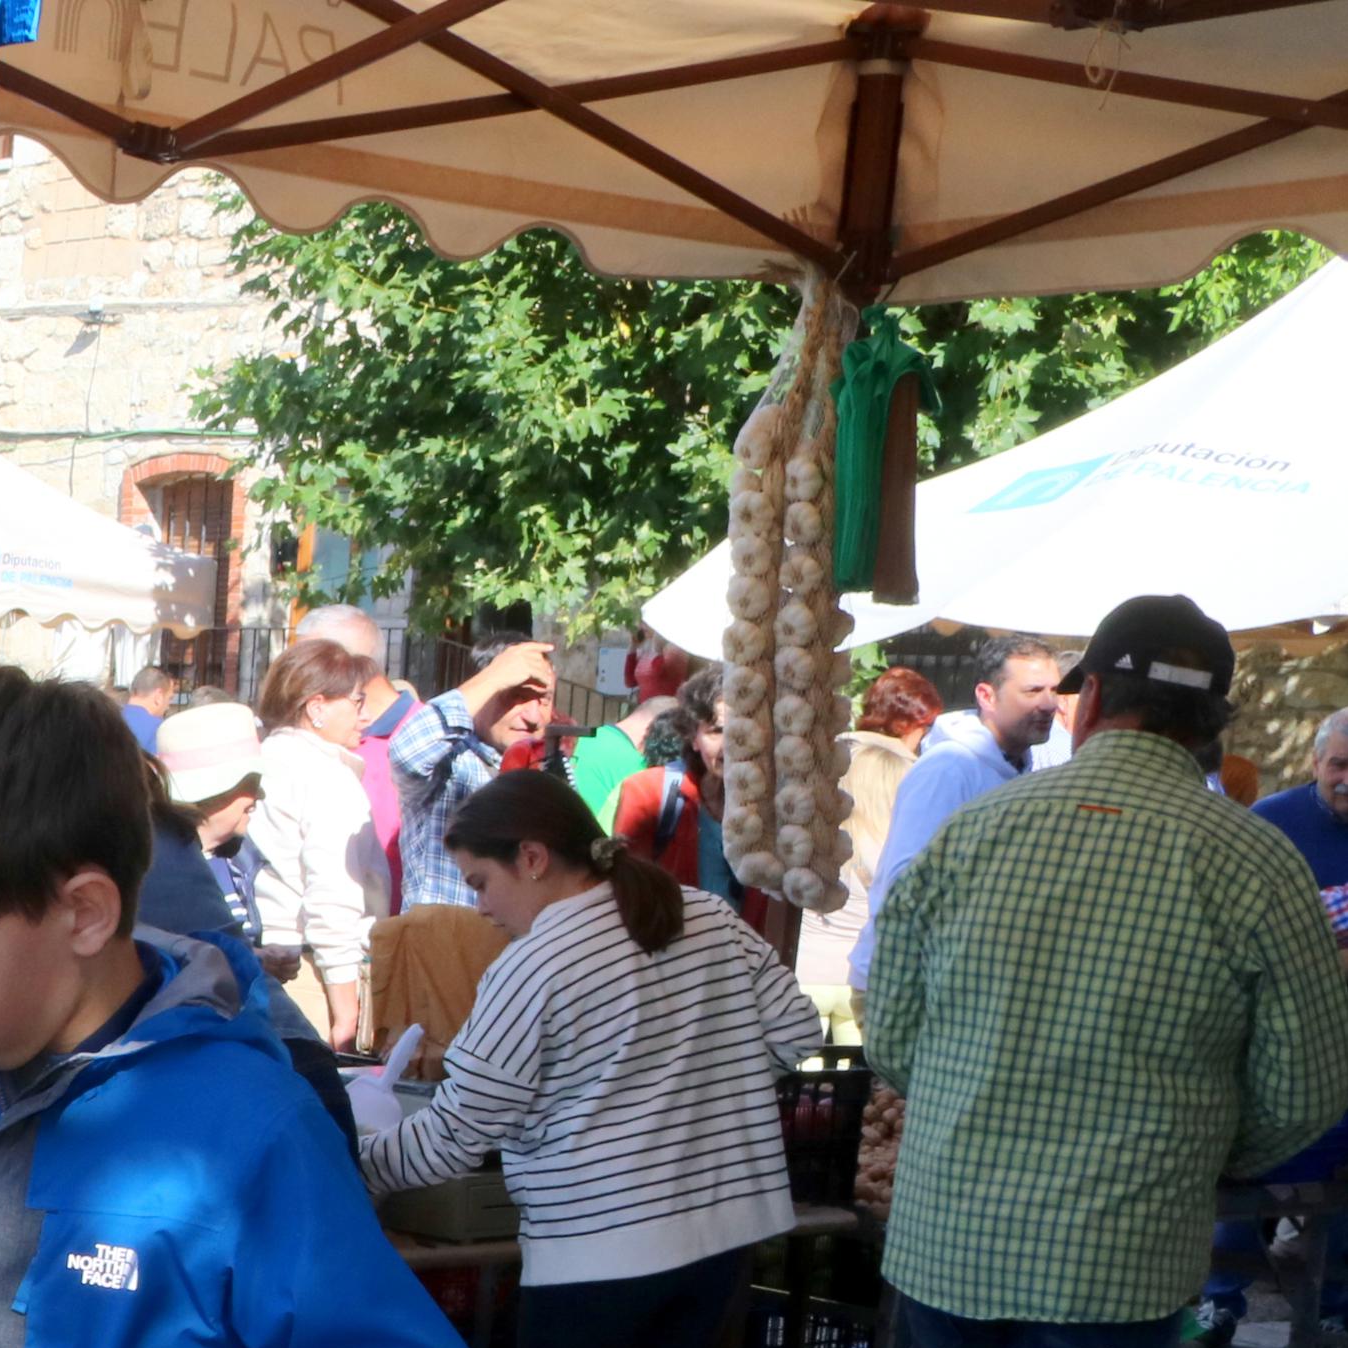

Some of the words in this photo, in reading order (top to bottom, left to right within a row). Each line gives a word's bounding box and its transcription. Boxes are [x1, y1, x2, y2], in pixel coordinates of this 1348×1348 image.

[1133, 461, 1312, 495] PALENCIA
[95, 1243, 126, 1261] THE
[67, 1253, 124, 1275] NORTH
[81, 1270, 121, 1290] FACE
